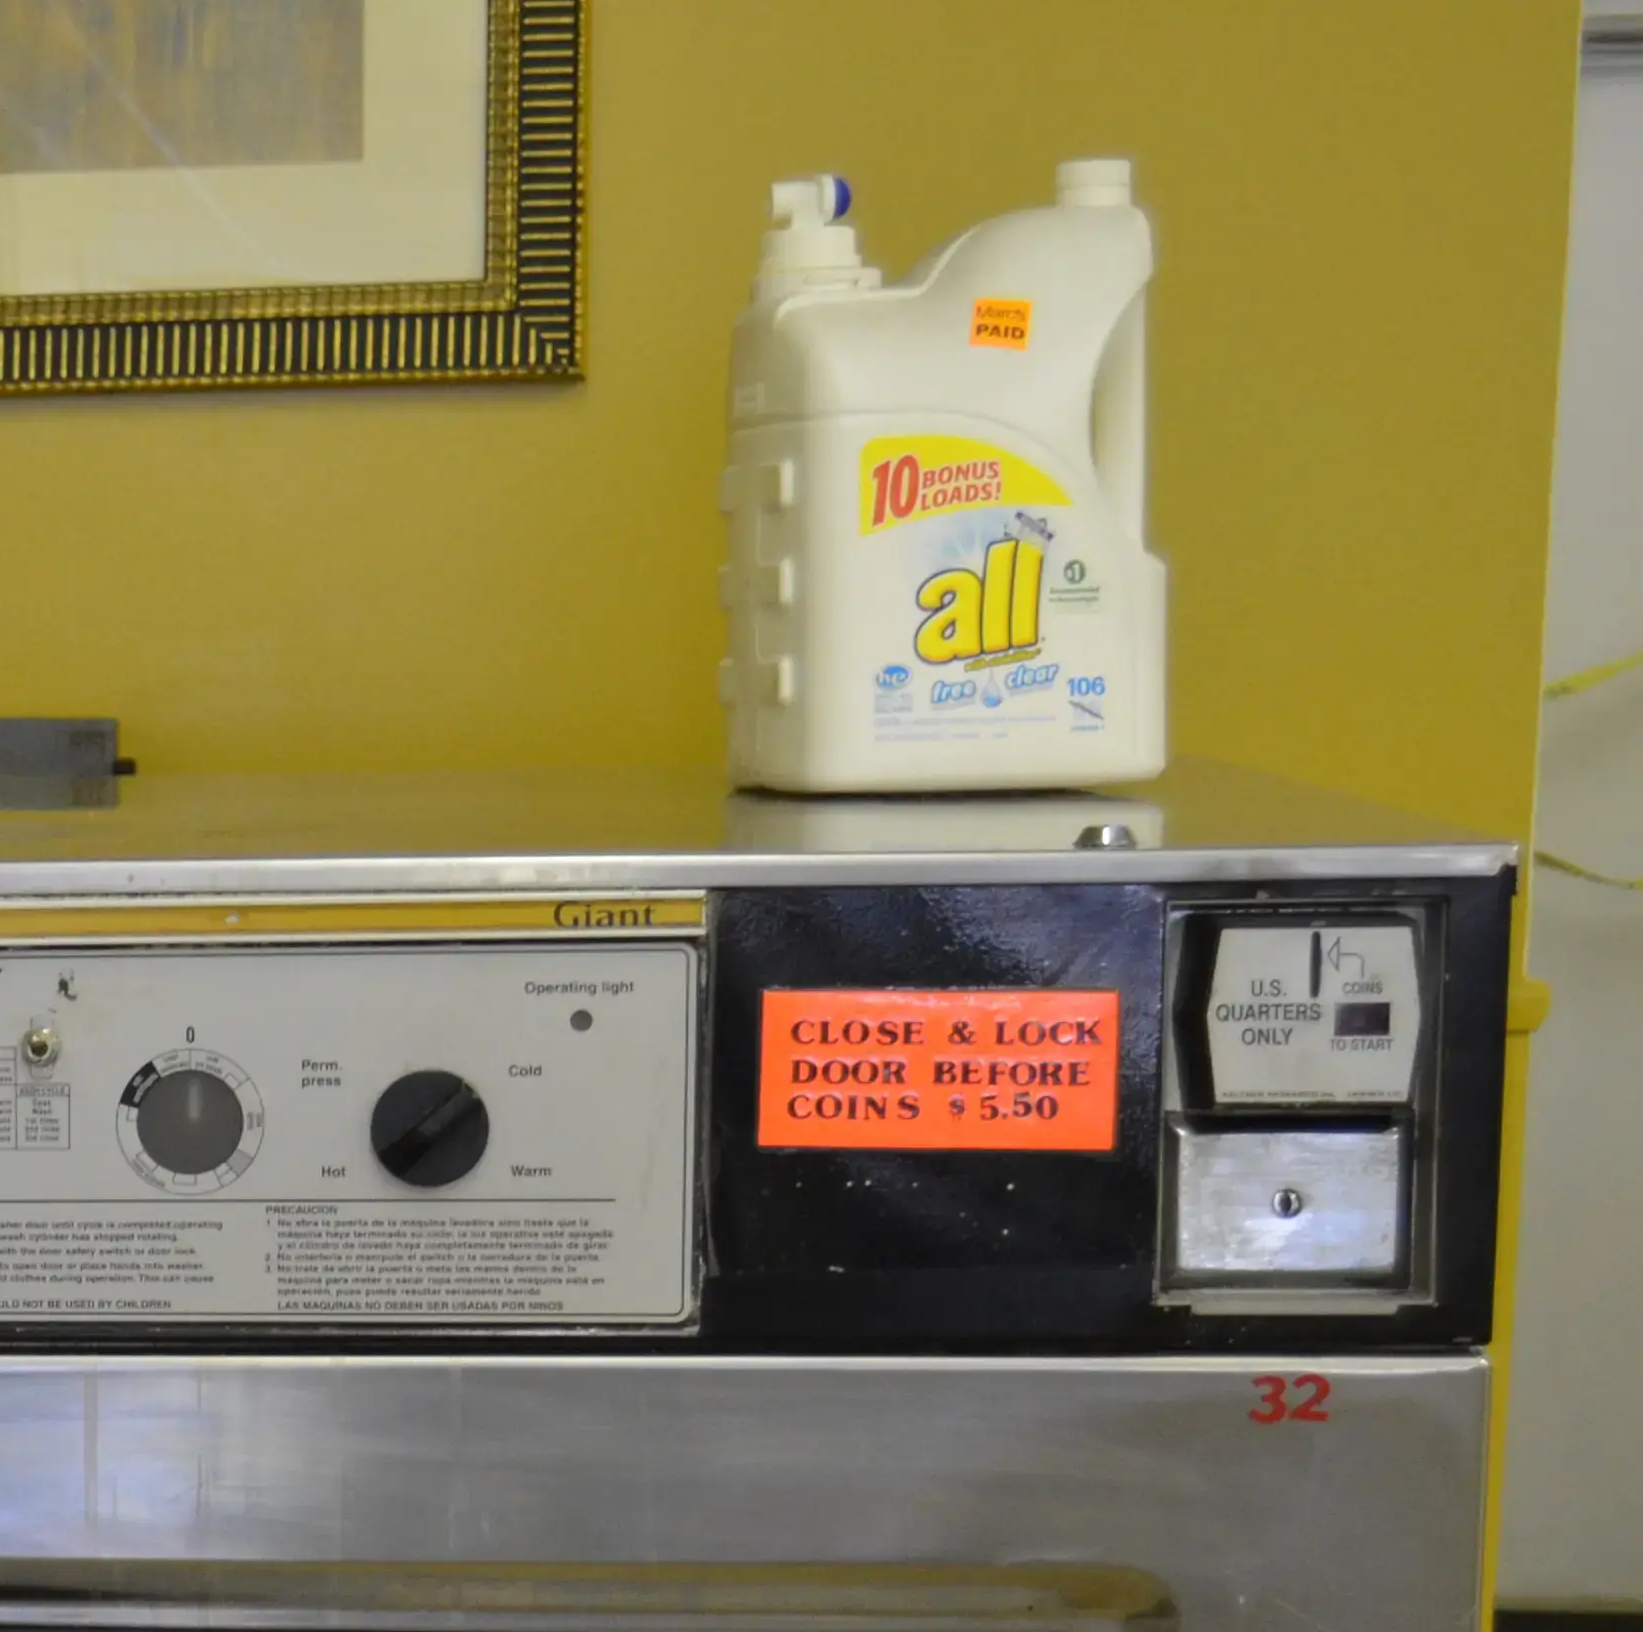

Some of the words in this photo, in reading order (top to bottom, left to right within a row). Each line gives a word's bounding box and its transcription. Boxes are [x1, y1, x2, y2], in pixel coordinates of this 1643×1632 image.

[977, 324, 1025, 340] PAID
[922, 461, 1000, 489] BONUS
[872, 454, 920, 527] 10
[920, 481, 1002, 511] LOADS!
[914, 536, 1045, 666] all
[931, 680, 976, 704] free
[1005, 664, 1059, 690] clear
[1068, 677, 1106, 696] 106
[553, 901, 656, 928] Giant
[524, 981, 597, 995] Operating
[601, 980, 635, 994] light
[1251, 979, 1287, 997] U.S.
[1342, 981, 1383, 994] COINS
[1215, 1003, 1323, 1022] QUARTERS
[186, 1026, 195, 1043] 0
[791, 1020, 924, 1046] CLOSE
[948, 1021, 976, 1045] &
[995, 1020, 1101, 1046] LOCK
[1241, 1028, 1293, 1045] ONLY
[1330, 1038, 1346, 1051] TO
[1350, 1038, 1394, 1051] START
[302, 1059, 343, 1072] Perm.
[509, 1065, 542, 1078] Cold
[790, 1060, 906, 1085] DOOR
[933, 1060, 1090, 1087] BEFORE
[302, 1075, 341, 1088] press
[787, 1094, 920, 1121] COINS
[949, 1094, 965, 1116] $
[980, 1092, 1059, 1122] 5.50
[321, 1166, 346, 1178] Hot
[511, 1165, 552, 1178] Warm
[22, 1299, 44, 1308] NOT
[47, 1299, 61, 1308] BE
[65, 1299, 94, 1309] USED
[98, 1299, 112, 1309] BY
[115, 1299, 171, 1309] CHILDREN
[1249, 1374, 1331, 1424] 32
